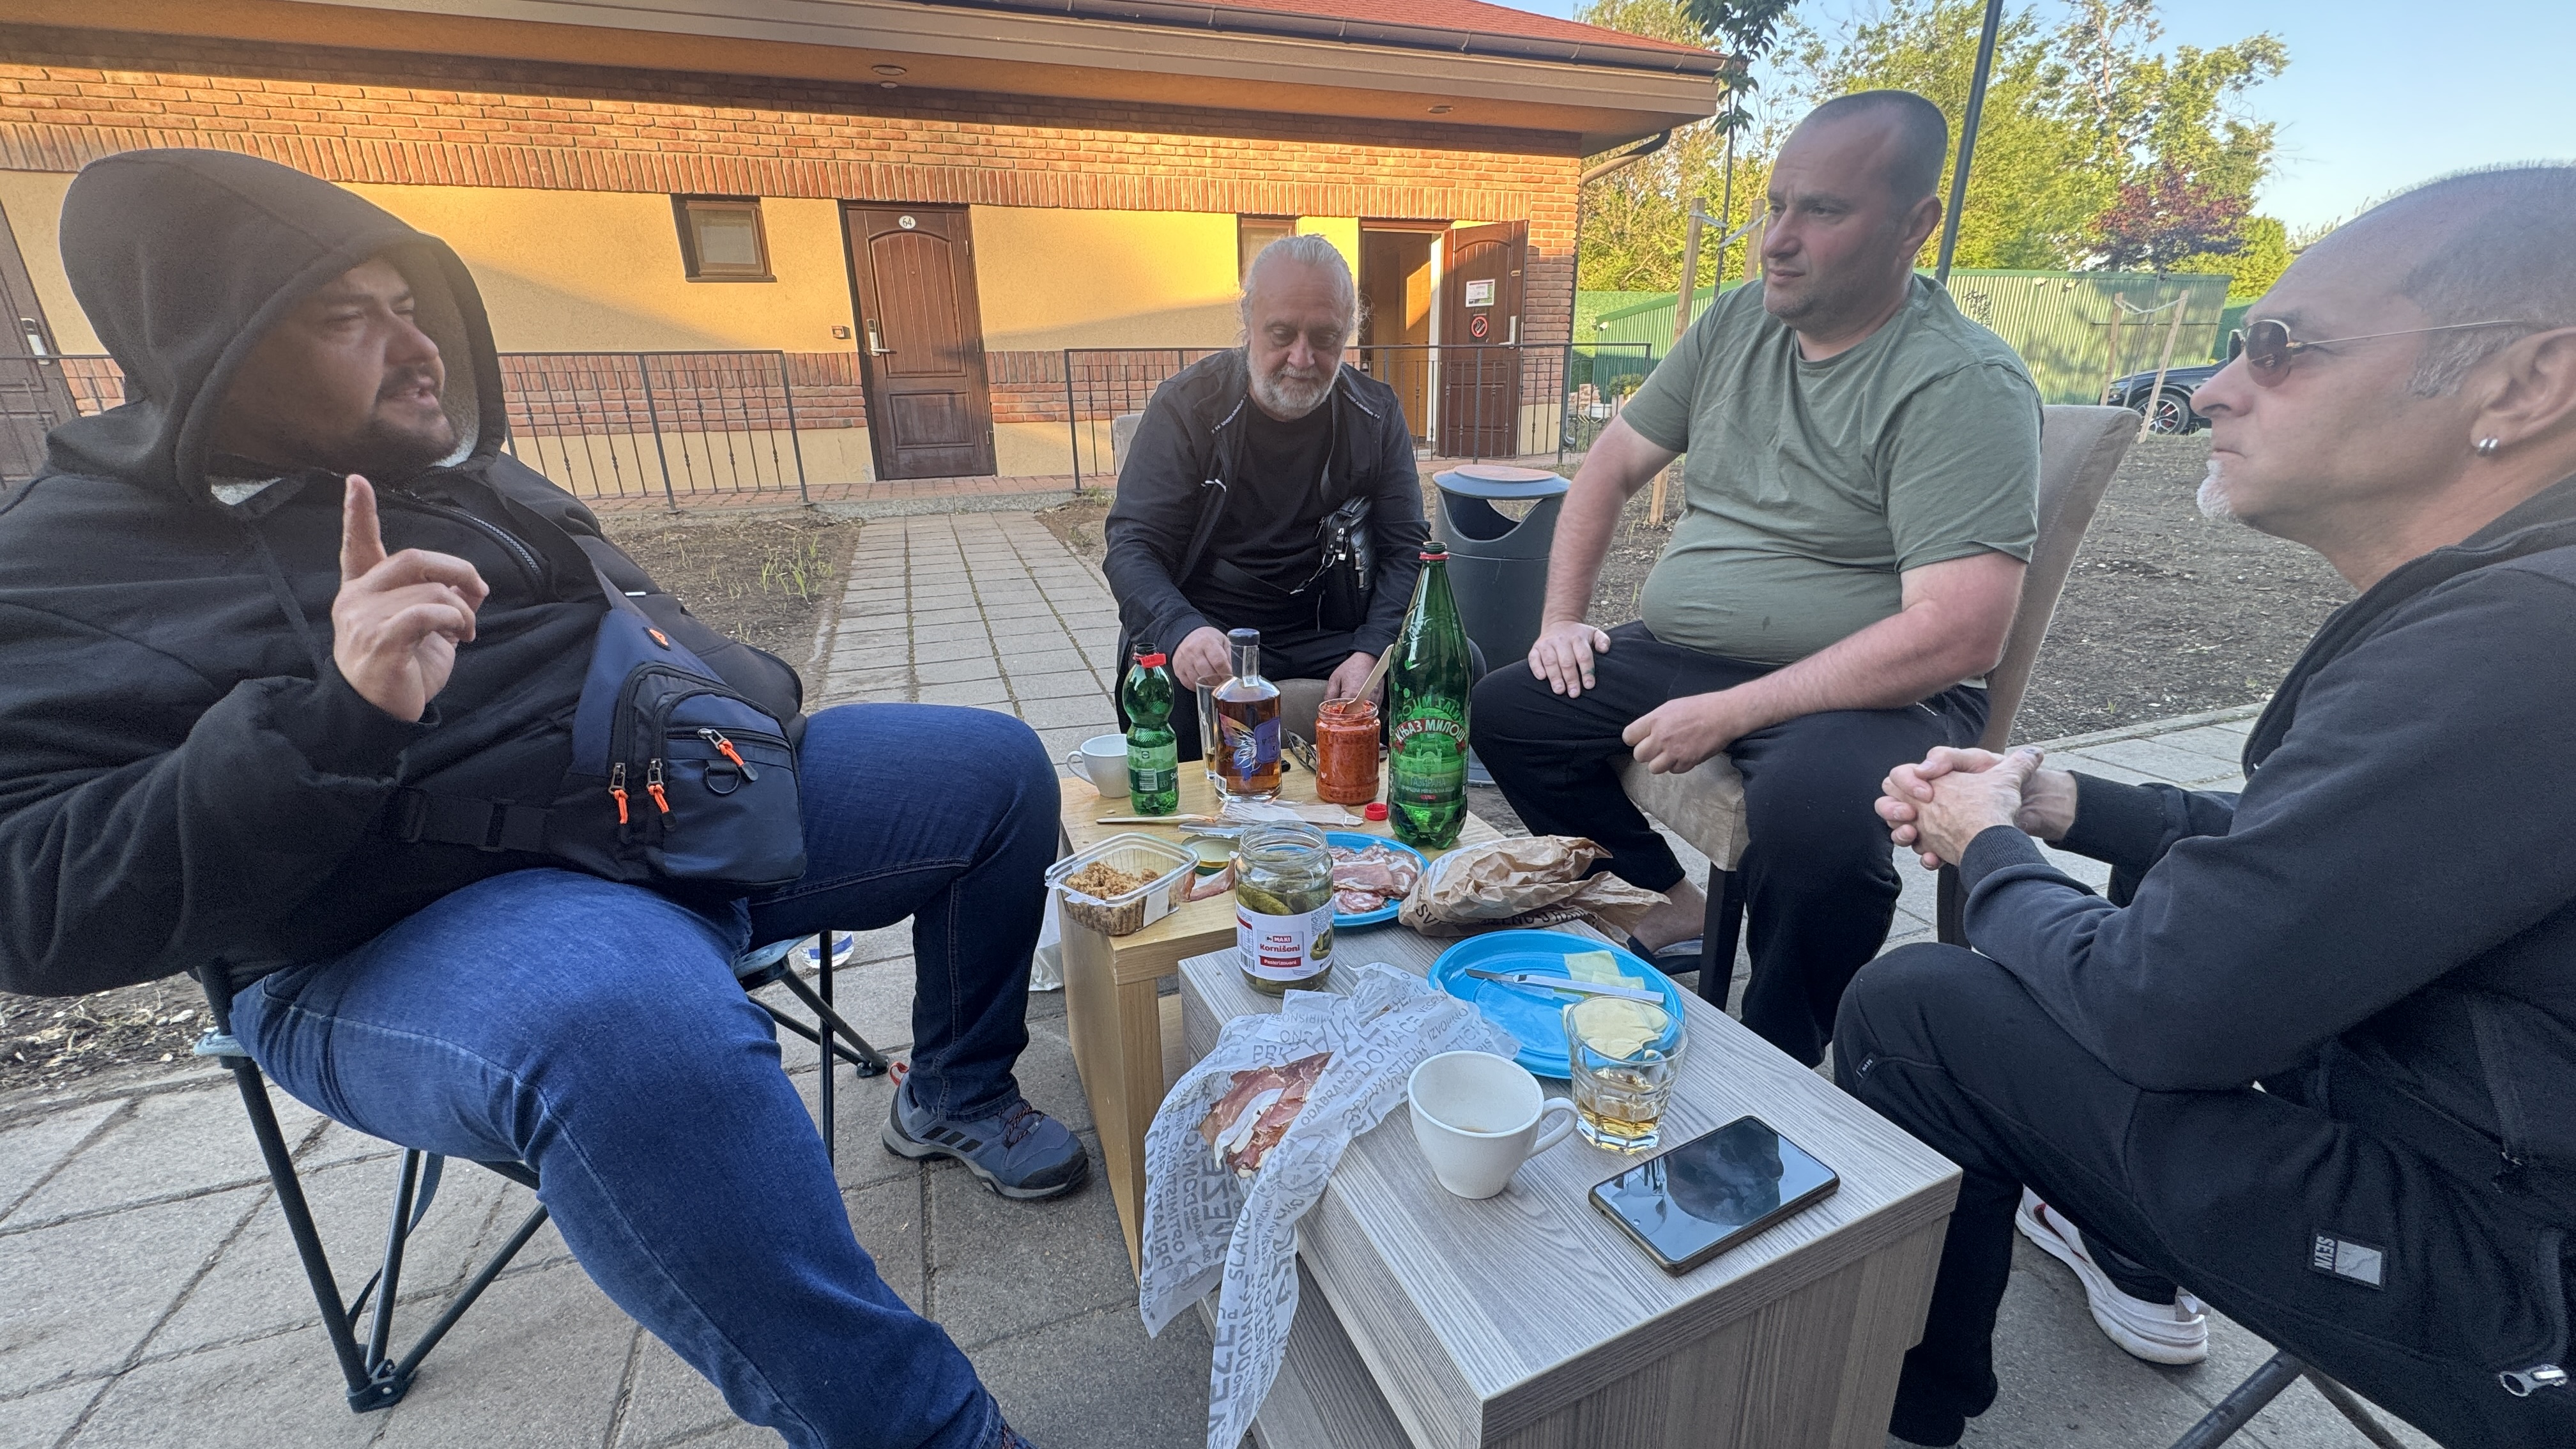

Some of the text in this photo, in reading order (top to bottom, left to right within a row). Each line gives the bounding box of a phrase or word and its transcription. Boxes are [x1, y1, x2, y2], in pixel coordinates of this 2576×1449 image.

[903, 218, 912, 227] 64
[1395, 719, 1466, 742] КЊАЗ МИЛОШ
[1260, 944, 1300, 952] Kornišoni
[1301, 1070, 1354, 1126] ODABRANO
[1228, 1206, 1251, 1280] SLANO
